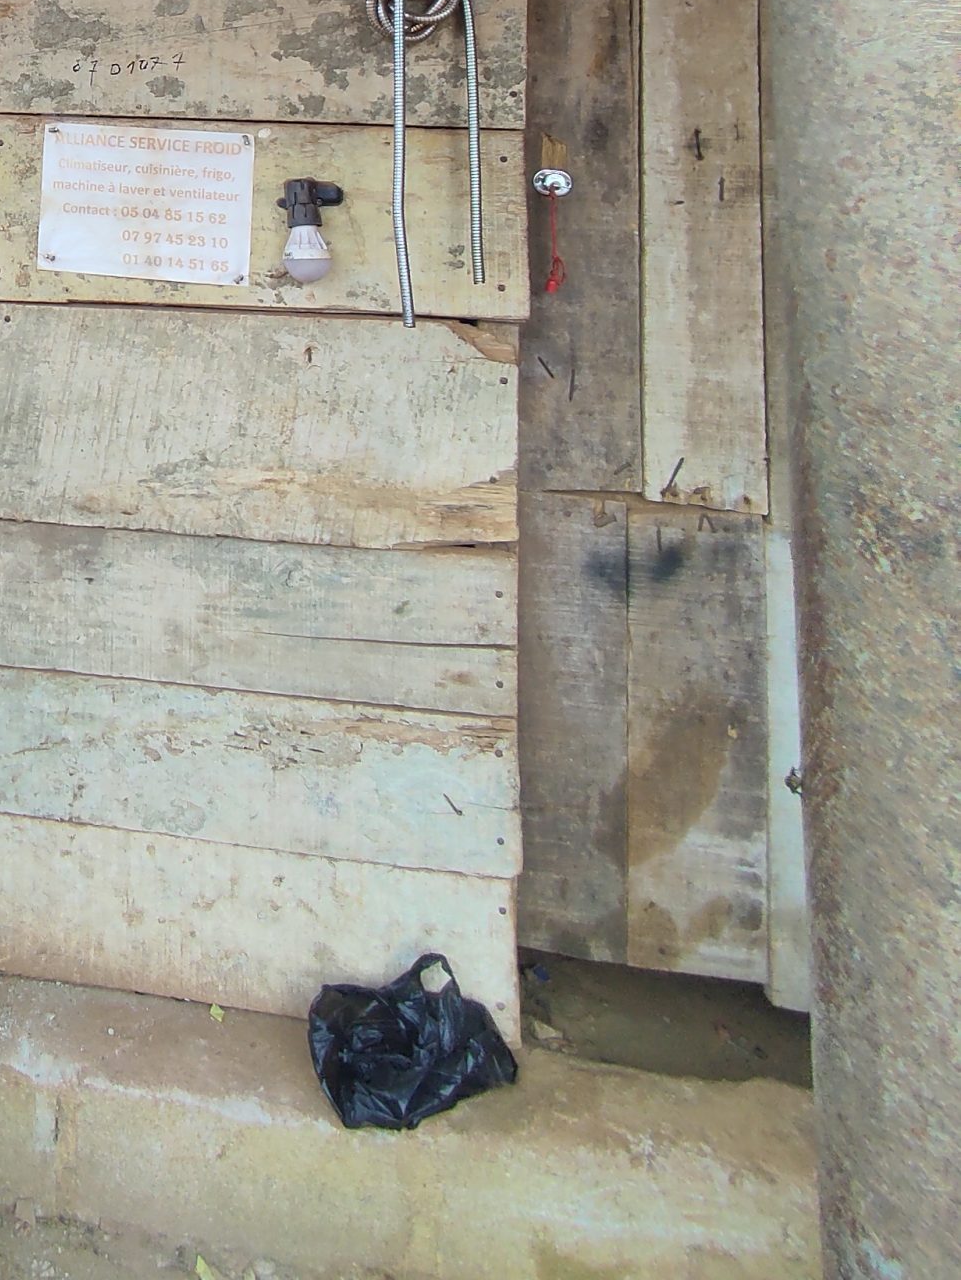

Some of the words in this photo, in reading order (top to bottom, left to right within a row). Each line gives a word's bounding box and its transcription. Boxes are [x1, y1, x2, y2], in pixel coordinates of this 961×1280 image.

[55, 132, 125, 149] ALLIANCE
[129, 136, 190, 153] SERVICE
[195, 140, 242, 156] FROID
[202, 166, 236, 182] frigo,
[53, 179, 105, 192] machine
[108, 181, 115, 193] à
[119, 183, 150, 196] laver
[153, 185, 166, 197] et
[169, 187, 240, 202] ventilateur
[62, 202, 110, 216] Contact
[121, 206, 139, 218] 05
[142, 208, 160, 219] 04
[187, 211, 204, 223] 15
[122, 230, 140, 242] 07
[144, 231, 161, 244] 97
[212, 237, 228, 249] 10
